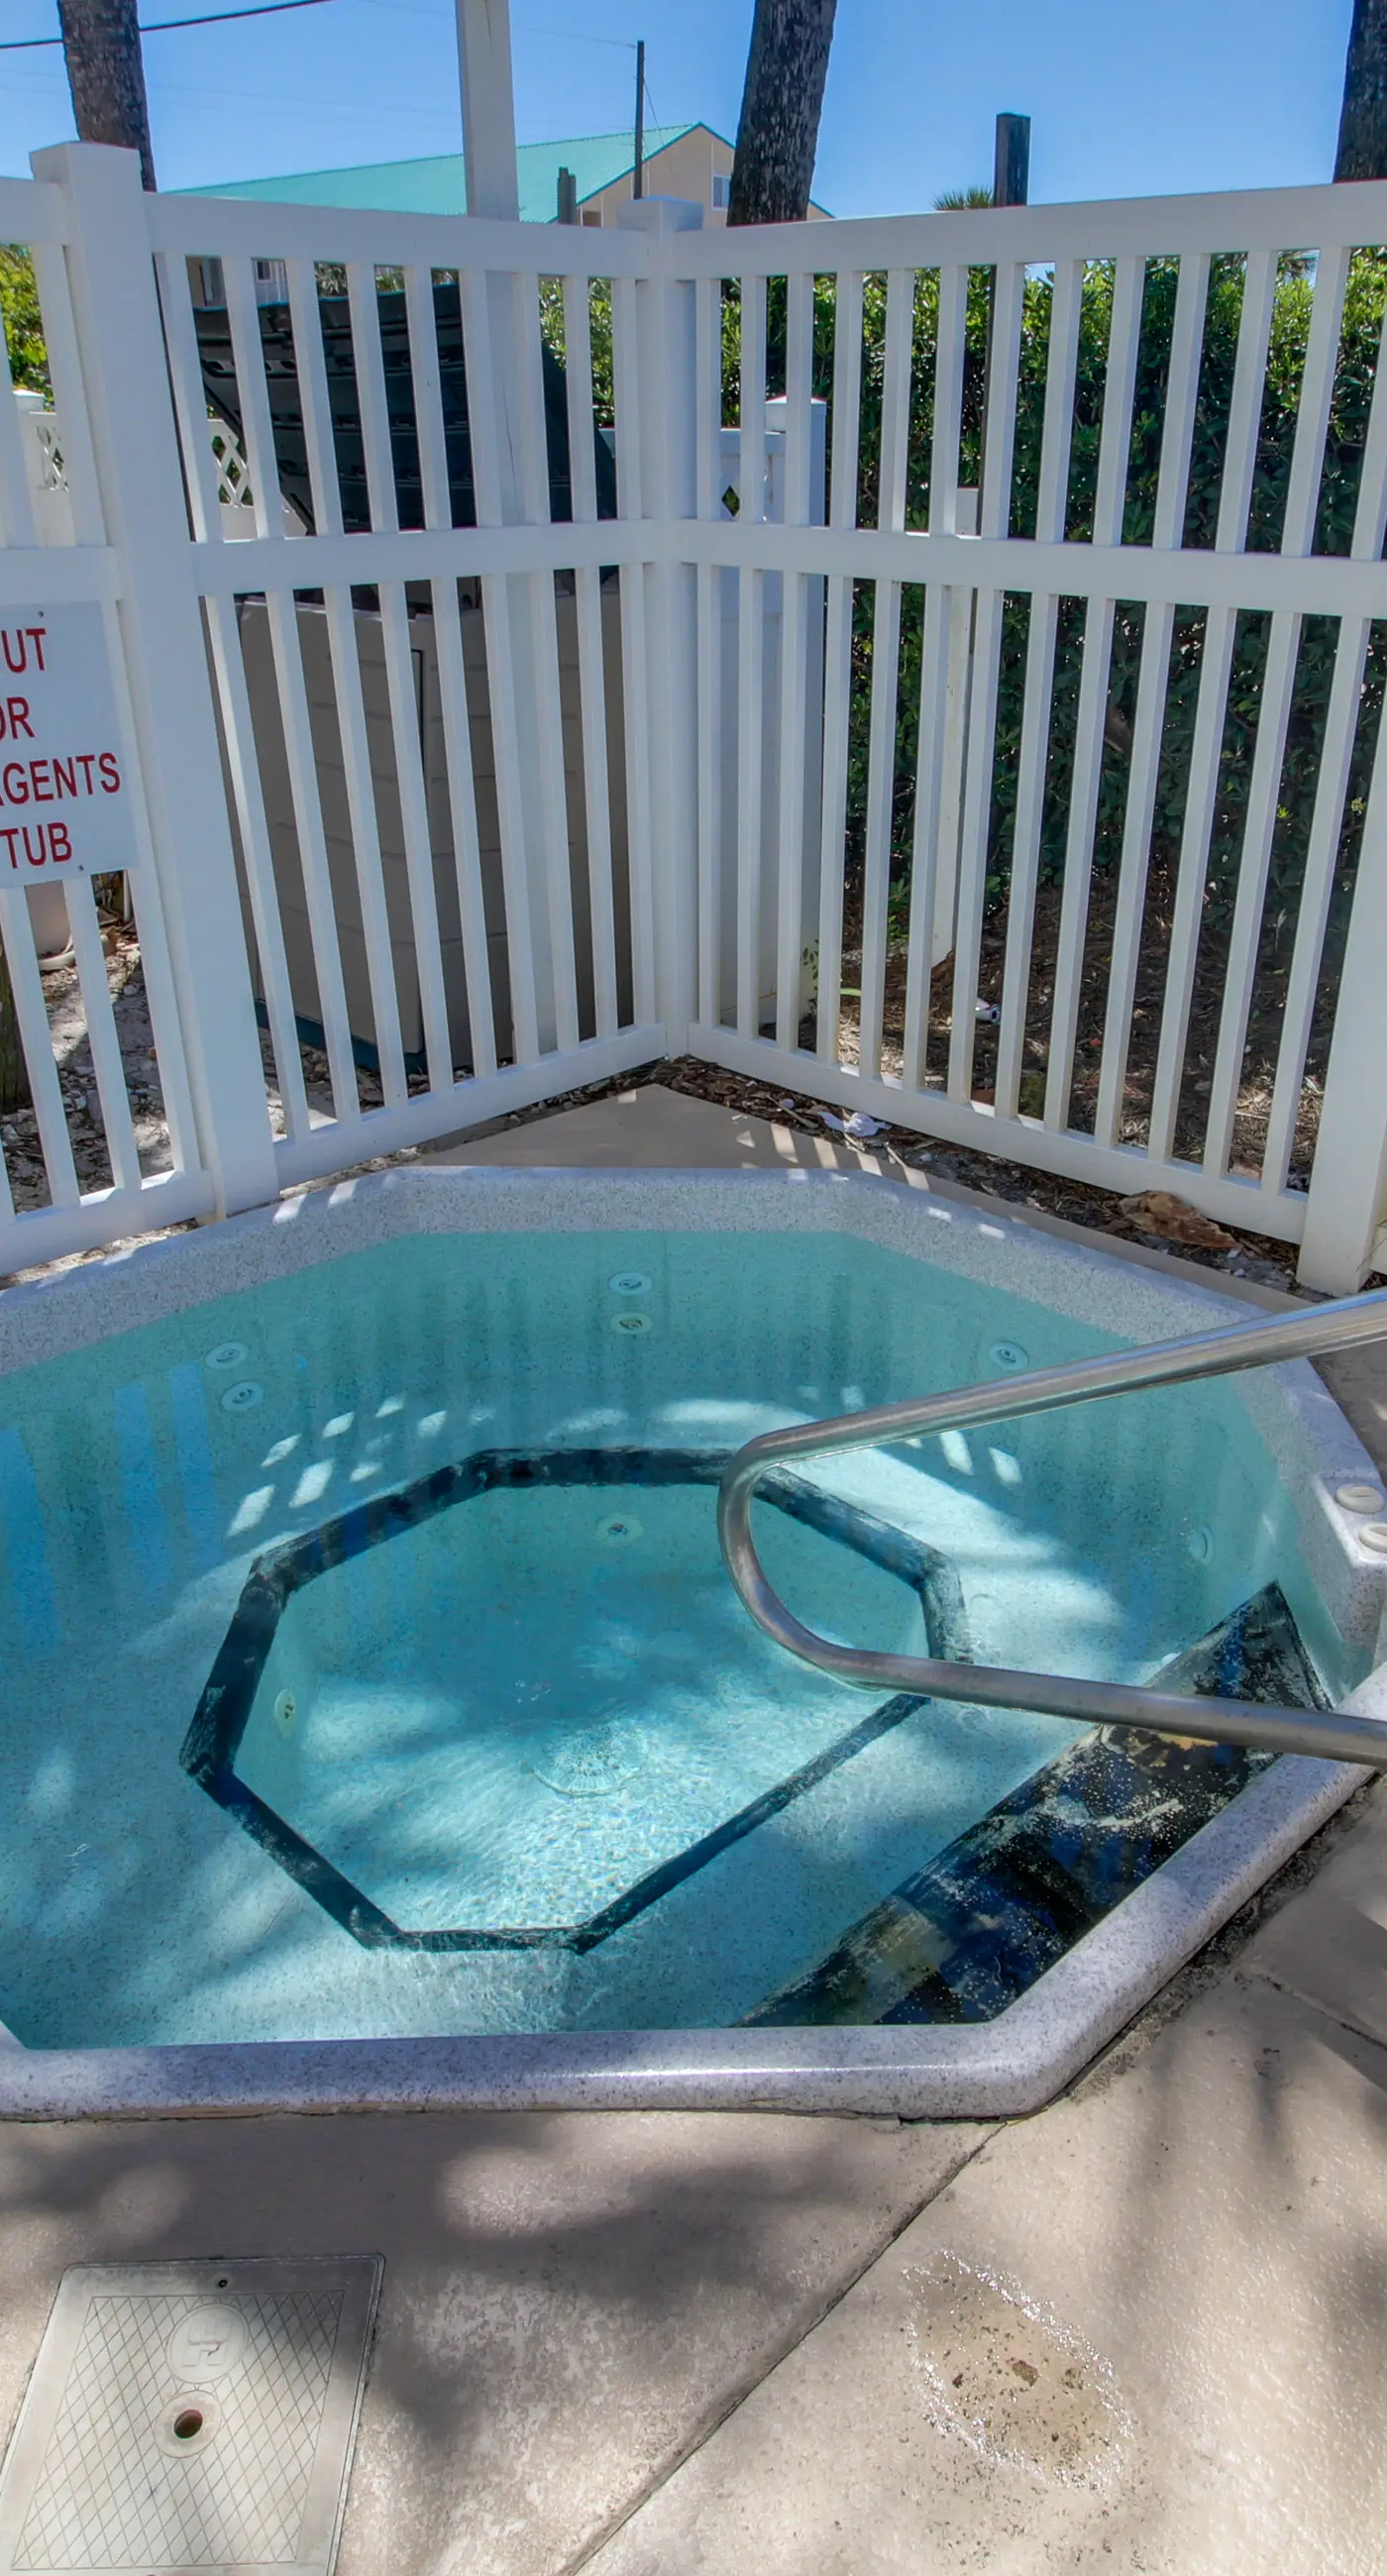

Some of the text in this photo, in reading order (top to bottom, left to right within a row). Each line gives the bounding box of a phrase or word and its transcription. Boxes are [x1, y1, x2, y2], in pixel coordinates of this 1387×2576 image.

[0, 627, 47, 674] UT
[0, 697, 36, 741] R
[0, 752, 121, 806] GENTS
[0, 821, 72, 869] TUB
